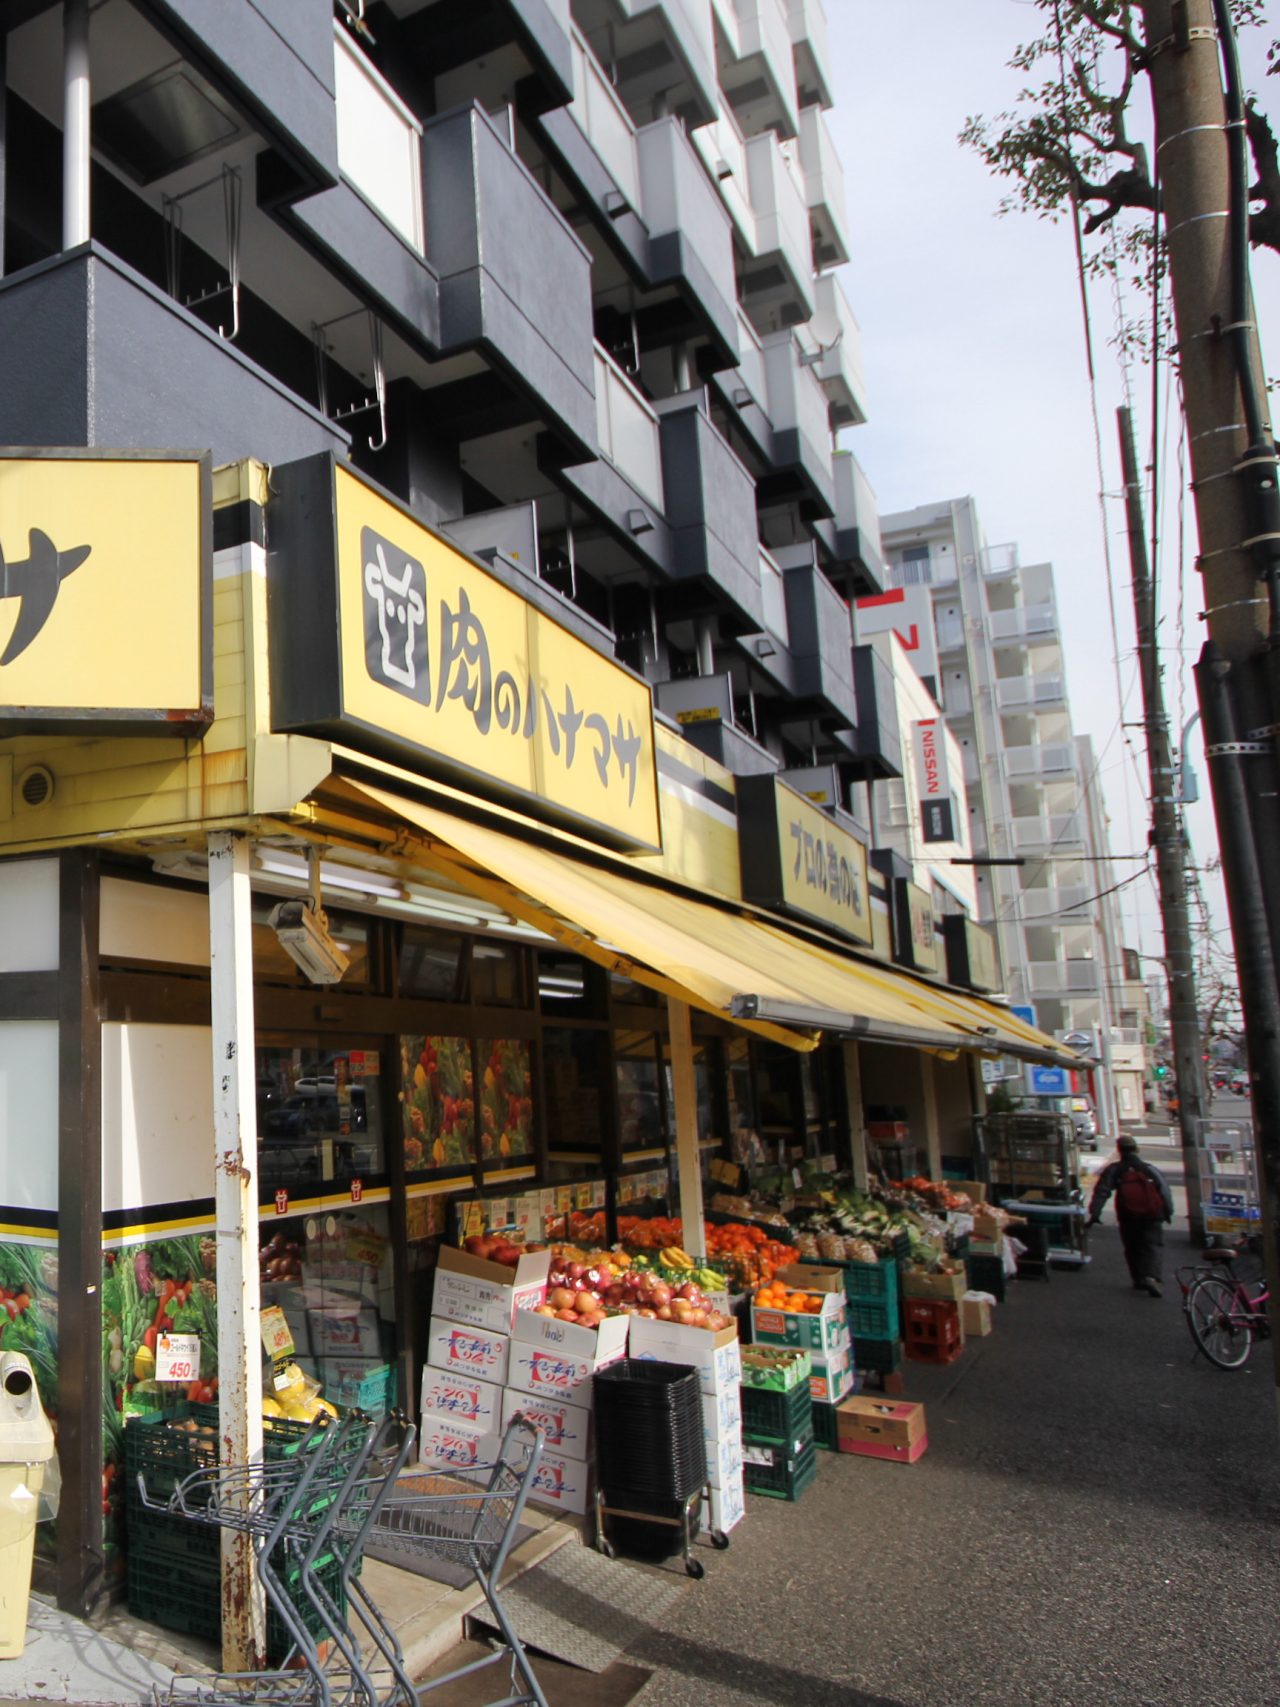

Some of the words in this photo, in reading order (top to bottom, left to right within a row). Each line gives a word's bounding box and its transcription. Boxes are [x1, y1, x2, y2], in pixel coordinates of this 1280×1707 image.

[435, 586, 642, 809] 肉のハナマサ
[921, 730, 939, 793] NISSAN
[169, 1362, 191, 1378] 450
